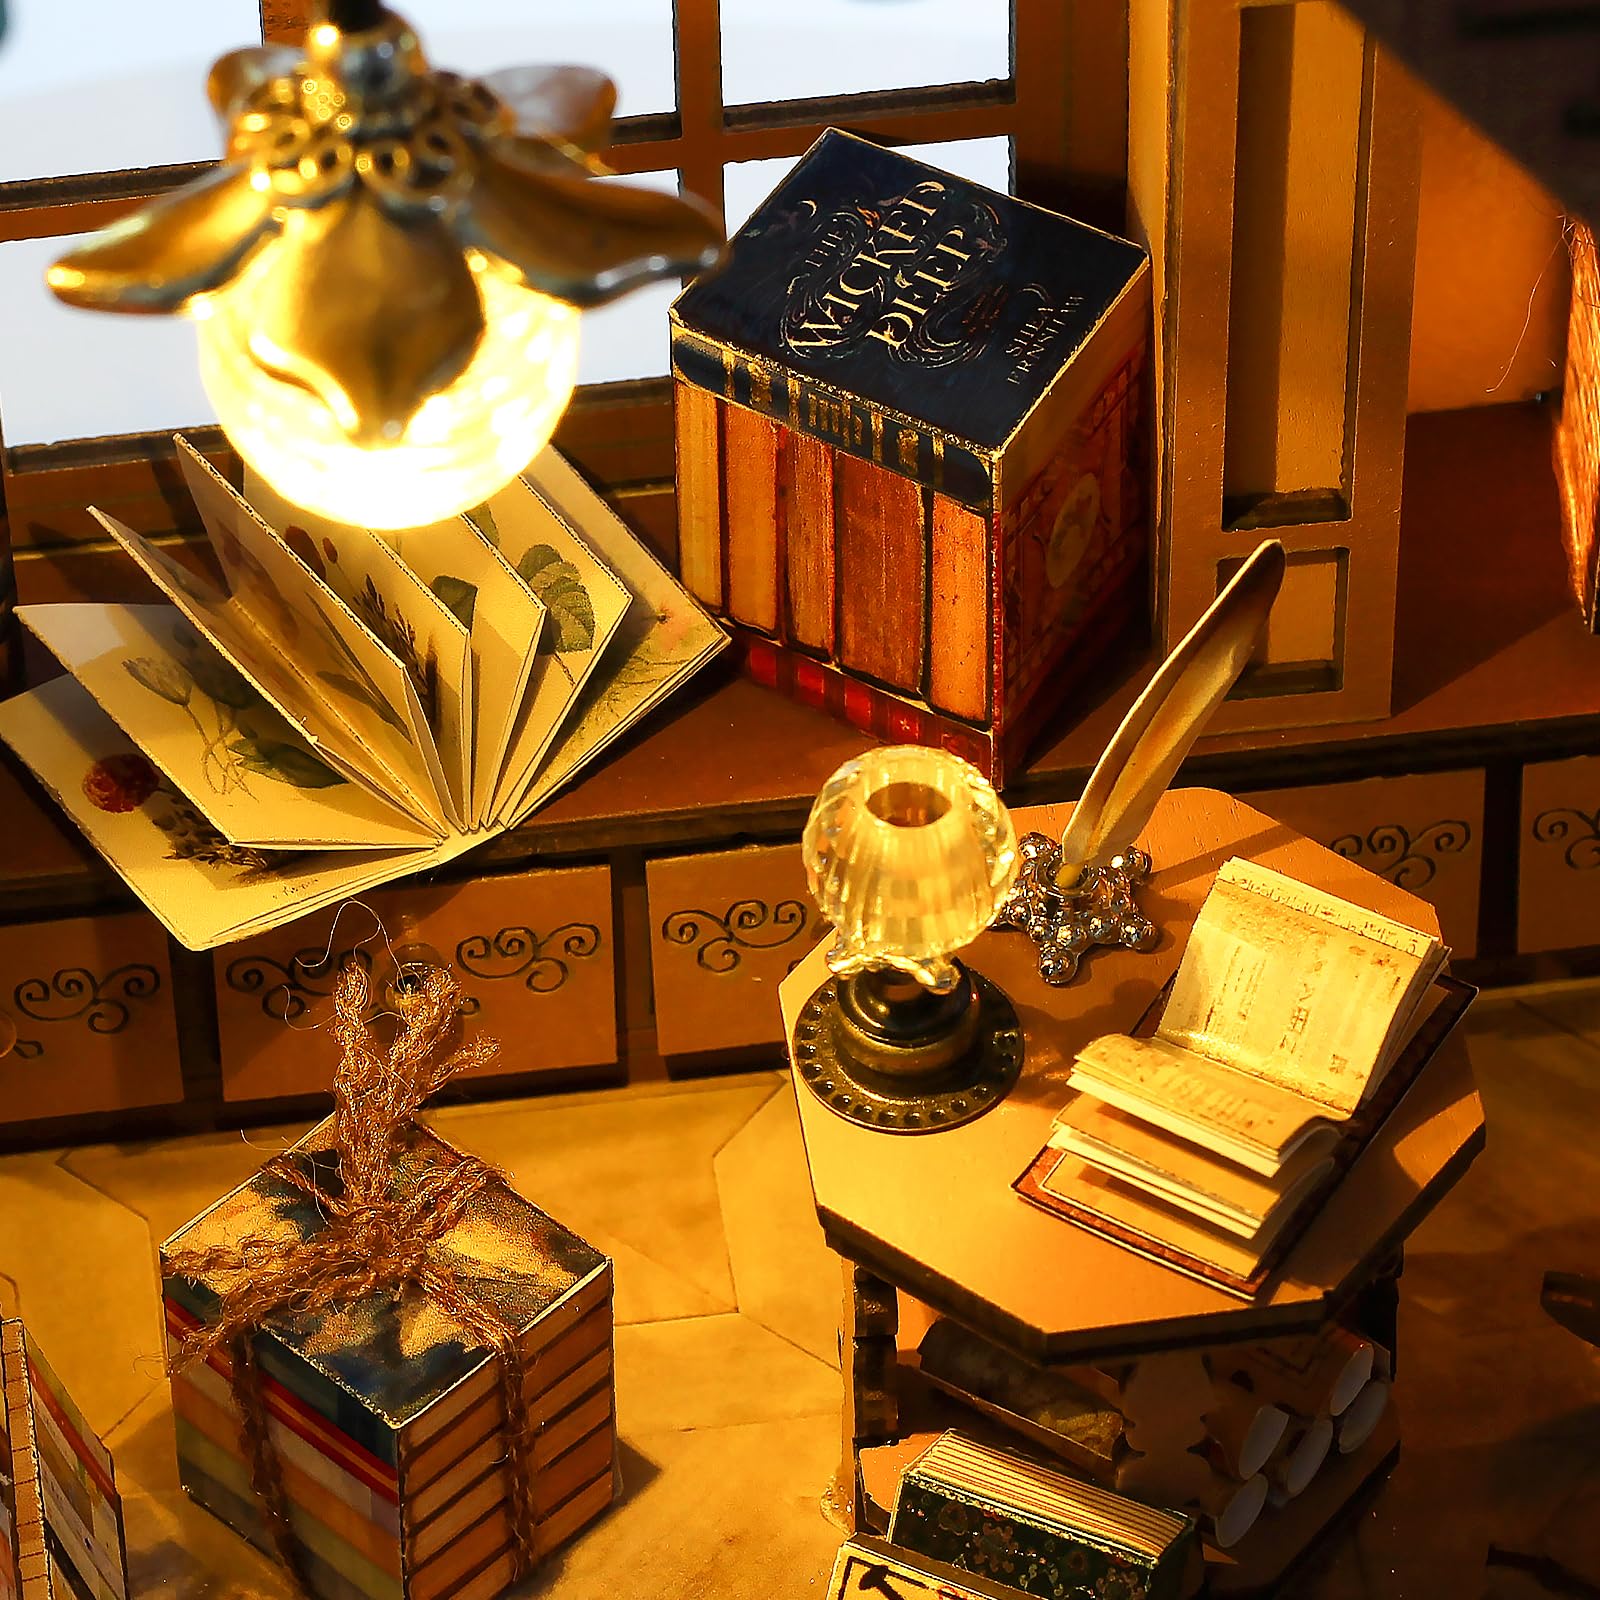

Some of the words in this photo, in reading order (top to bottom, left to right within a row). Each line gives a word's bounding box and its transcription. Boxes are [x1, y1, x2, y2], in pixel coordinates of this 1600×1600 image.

[788, 180, 946, 348] WICKED
[865, 228, 971, 348] DEEP
[1006, 307, 1054, 358] SHEA
